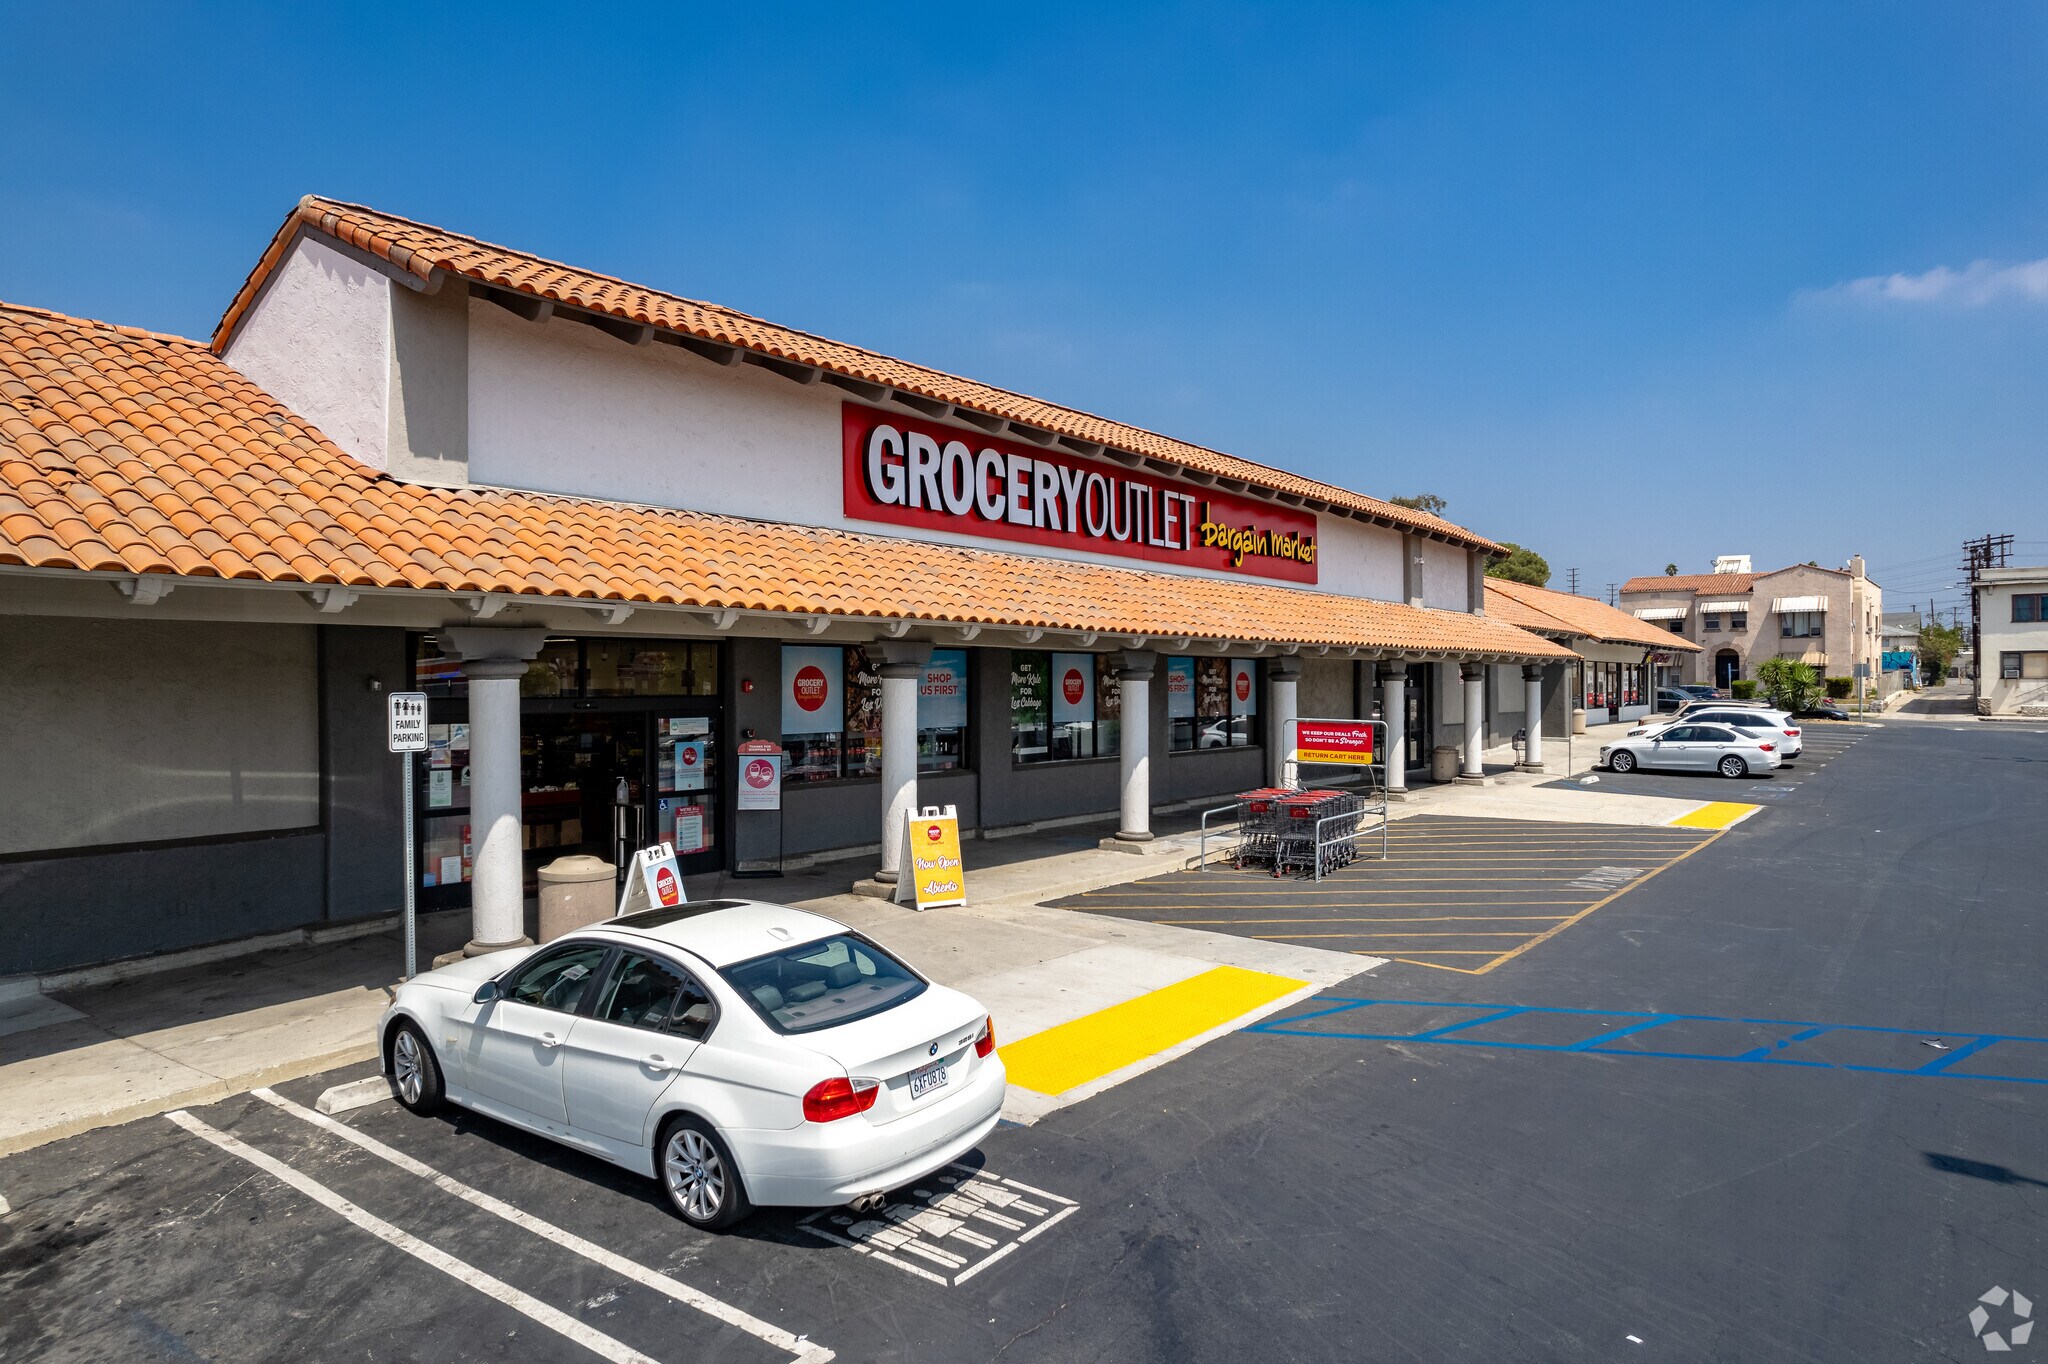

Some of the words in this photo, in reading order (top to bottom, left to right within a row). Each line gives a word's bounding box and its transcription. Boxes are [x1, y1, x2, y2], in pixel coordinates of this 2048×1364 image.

[868, 424, 1085, 533] GROCERY
[1085, 472, 1196, 550] OUTLET
[1020, 664, 1032, 672] GET
[797, 679, 824, 687] GROCERY
[927, 673, 952, 683] SHOP
[1010, 671, 1027, 686] More
[1026, 672, 1042, 686] Kale
[1169, 675, 1185, 683] SHOP
[801, 687, 820, 695] OUTLET
[871, 688, 882, 696] FO
[920, 686, 933, 695] US
[934, 685, 958, 695] FIRST
[1020, 687, 1033, 695] FOR
[395, 719, 421, 730] FAMILY
[393, 732, 424, 743] PARKING
[915, 857, 936, 870] Now
[937, 855, 960, 870] Open
[923, 880, 958, 895] Abierto
[914, 1066, 947, 1092] 6XFU878
